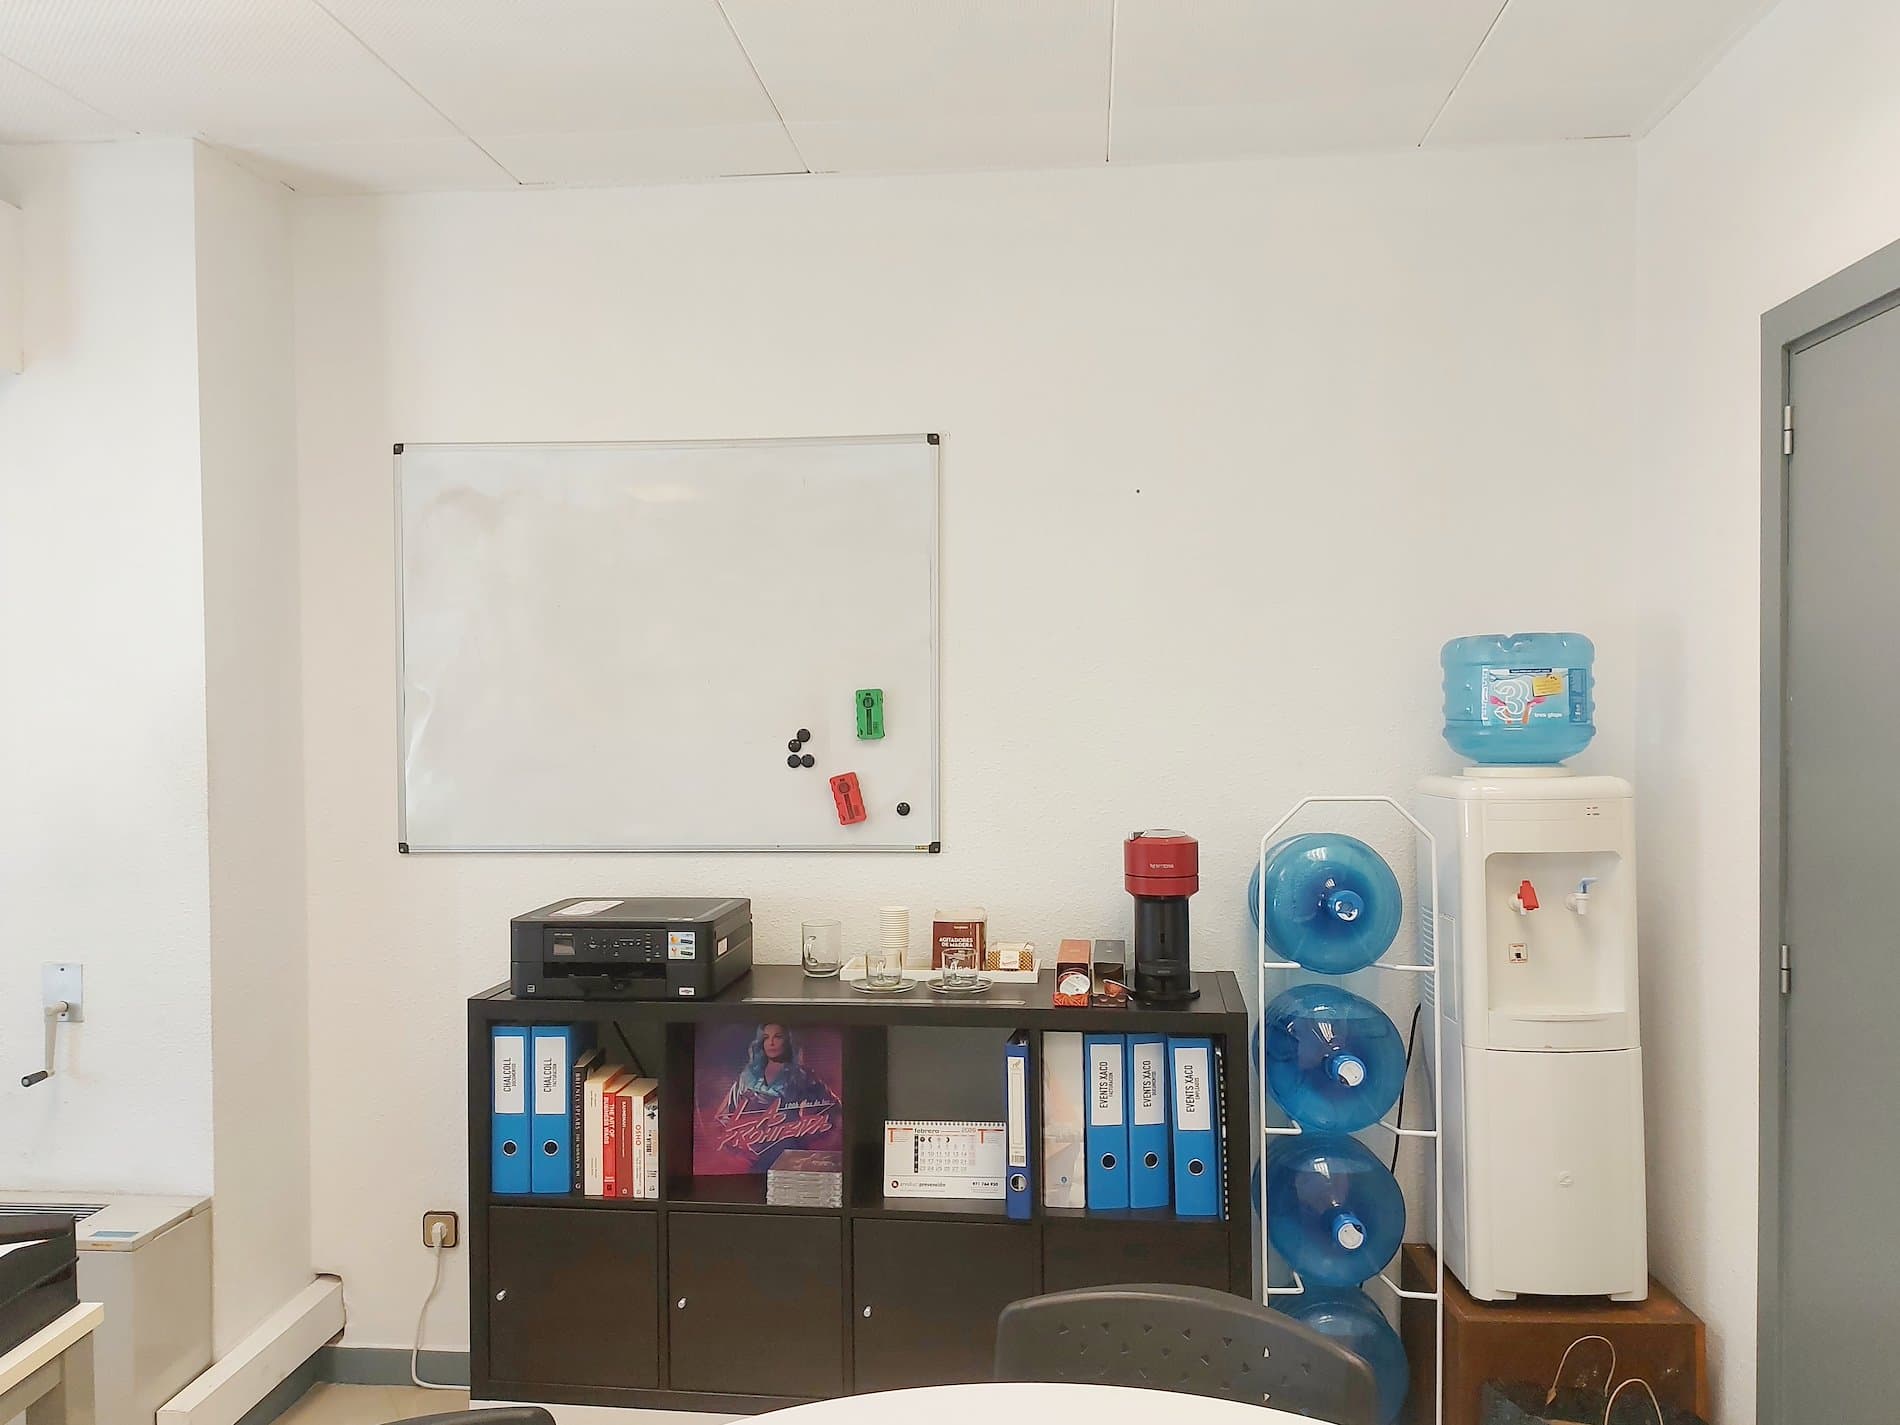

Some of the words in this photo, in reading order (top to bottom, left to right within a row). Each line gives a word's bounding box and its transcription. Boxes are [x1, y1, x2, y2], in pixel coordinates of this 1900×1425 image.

[503, 1057, 512, 1093] CHALCOLL
[543, 1057, 552, 1093] CHALCOLL
[1099, 1061, 1108, 1080] XACO
[1142, 1060, 1151, 1080] XACO
[1184, 1064, 1194, 1084] XACO
[1099, 1081, 1108, 1109] EVENTS
[1142, 1080, 1152, 1108] EVENTS
[1185, 1084, 1195, 1113] EVENTS
[608, 1103, 616, 1116] THE
[608, 1116, 616, 1129] ART
[608, 1129, 616, 1138] OF
